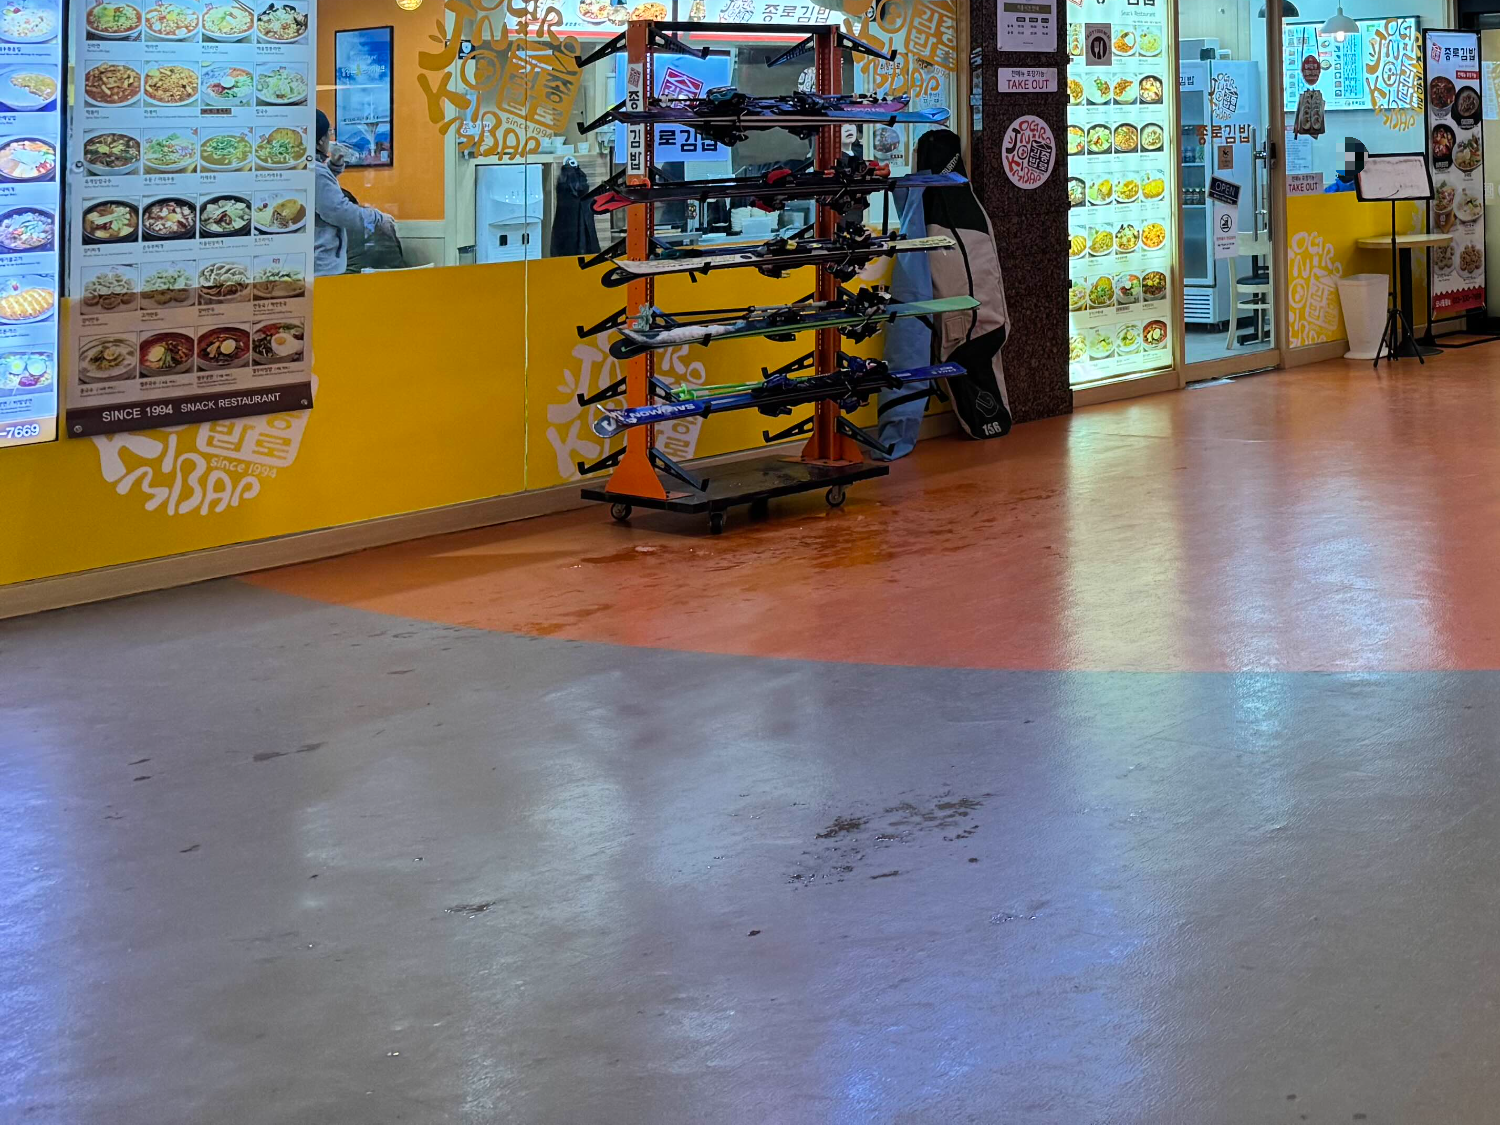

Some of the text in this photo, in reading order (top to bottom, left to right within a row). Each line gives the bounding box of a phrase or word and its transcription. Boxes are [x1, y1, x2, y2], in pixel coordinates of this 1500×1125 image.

[762, 2, 832, 25] 종로김밥
[1444, 47, 1476, 61] 종로김밥
[1006, 79, 1049, 90] TAKE OUT
[505, 116, 530, 133] since
[628, 90, 642, 171] 종김밥
[1196, 123, 1251, 145] 종로김밥
[1215, 181, 1236, 197] OPEN
[1288, 181, 1319, 193] TAKE OUT
[102, 392, 282, 422] SINCE 1994 SNACK RESTAURANT
[981, 421, 1002, 436] 156
[210, 456, 278, 479] since 1994
